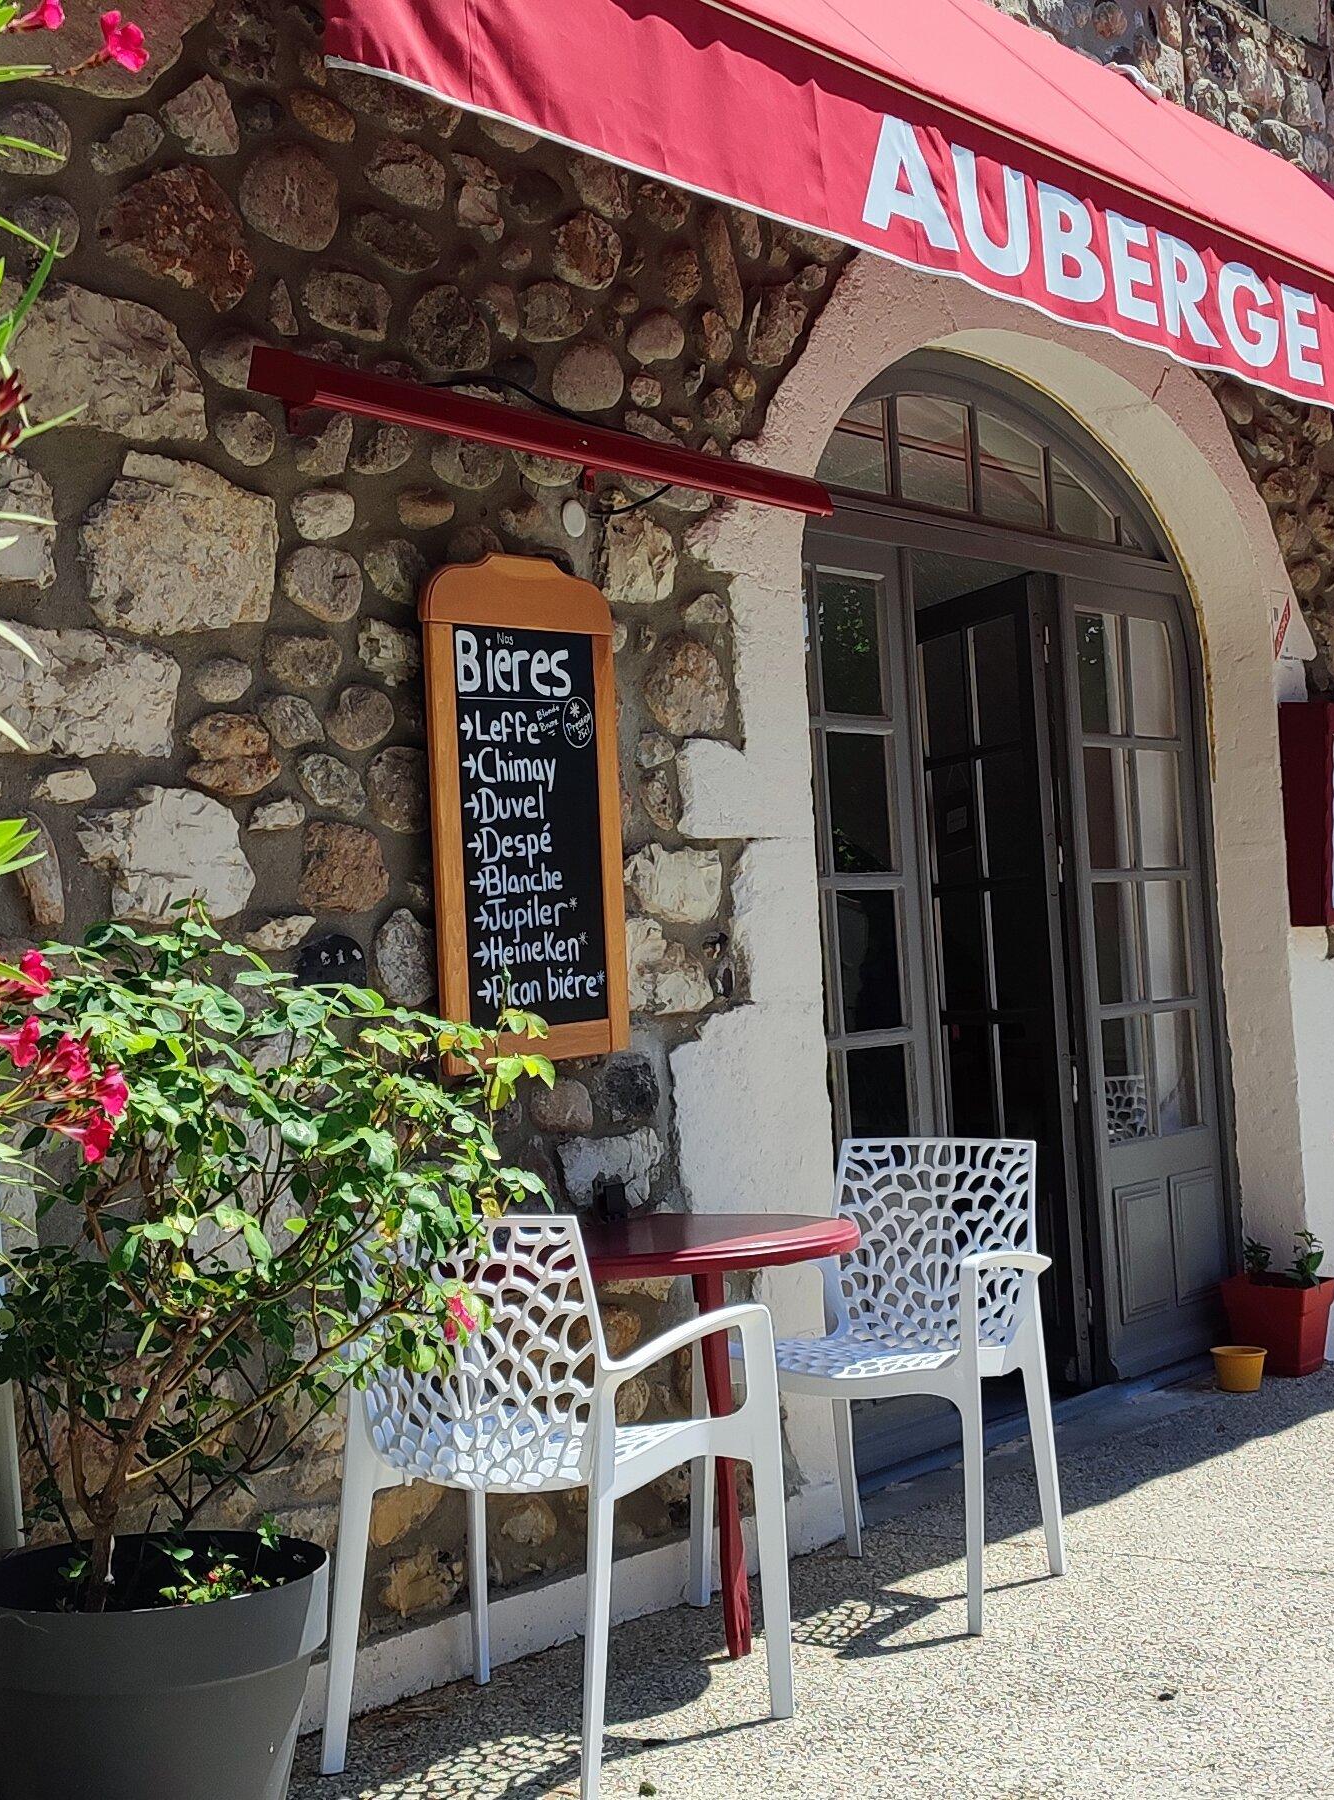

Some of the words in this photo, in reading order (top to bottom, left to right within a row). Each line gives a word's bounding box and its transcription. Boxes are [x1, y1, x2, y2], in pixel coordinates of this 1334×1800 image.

[862, 114, 1325, 386] AUBERGE
[496, 631, 514, 646] Nos
[475, 710, 542, 744] Leffe
[477, 747, 556, 792] Chimay
[477, 784, 545, 823] Duvel
[479, 822, 553, 868] Despé
[481, 862, 563, 897] Blanche
[491, 974, 542, 1009] Picon
